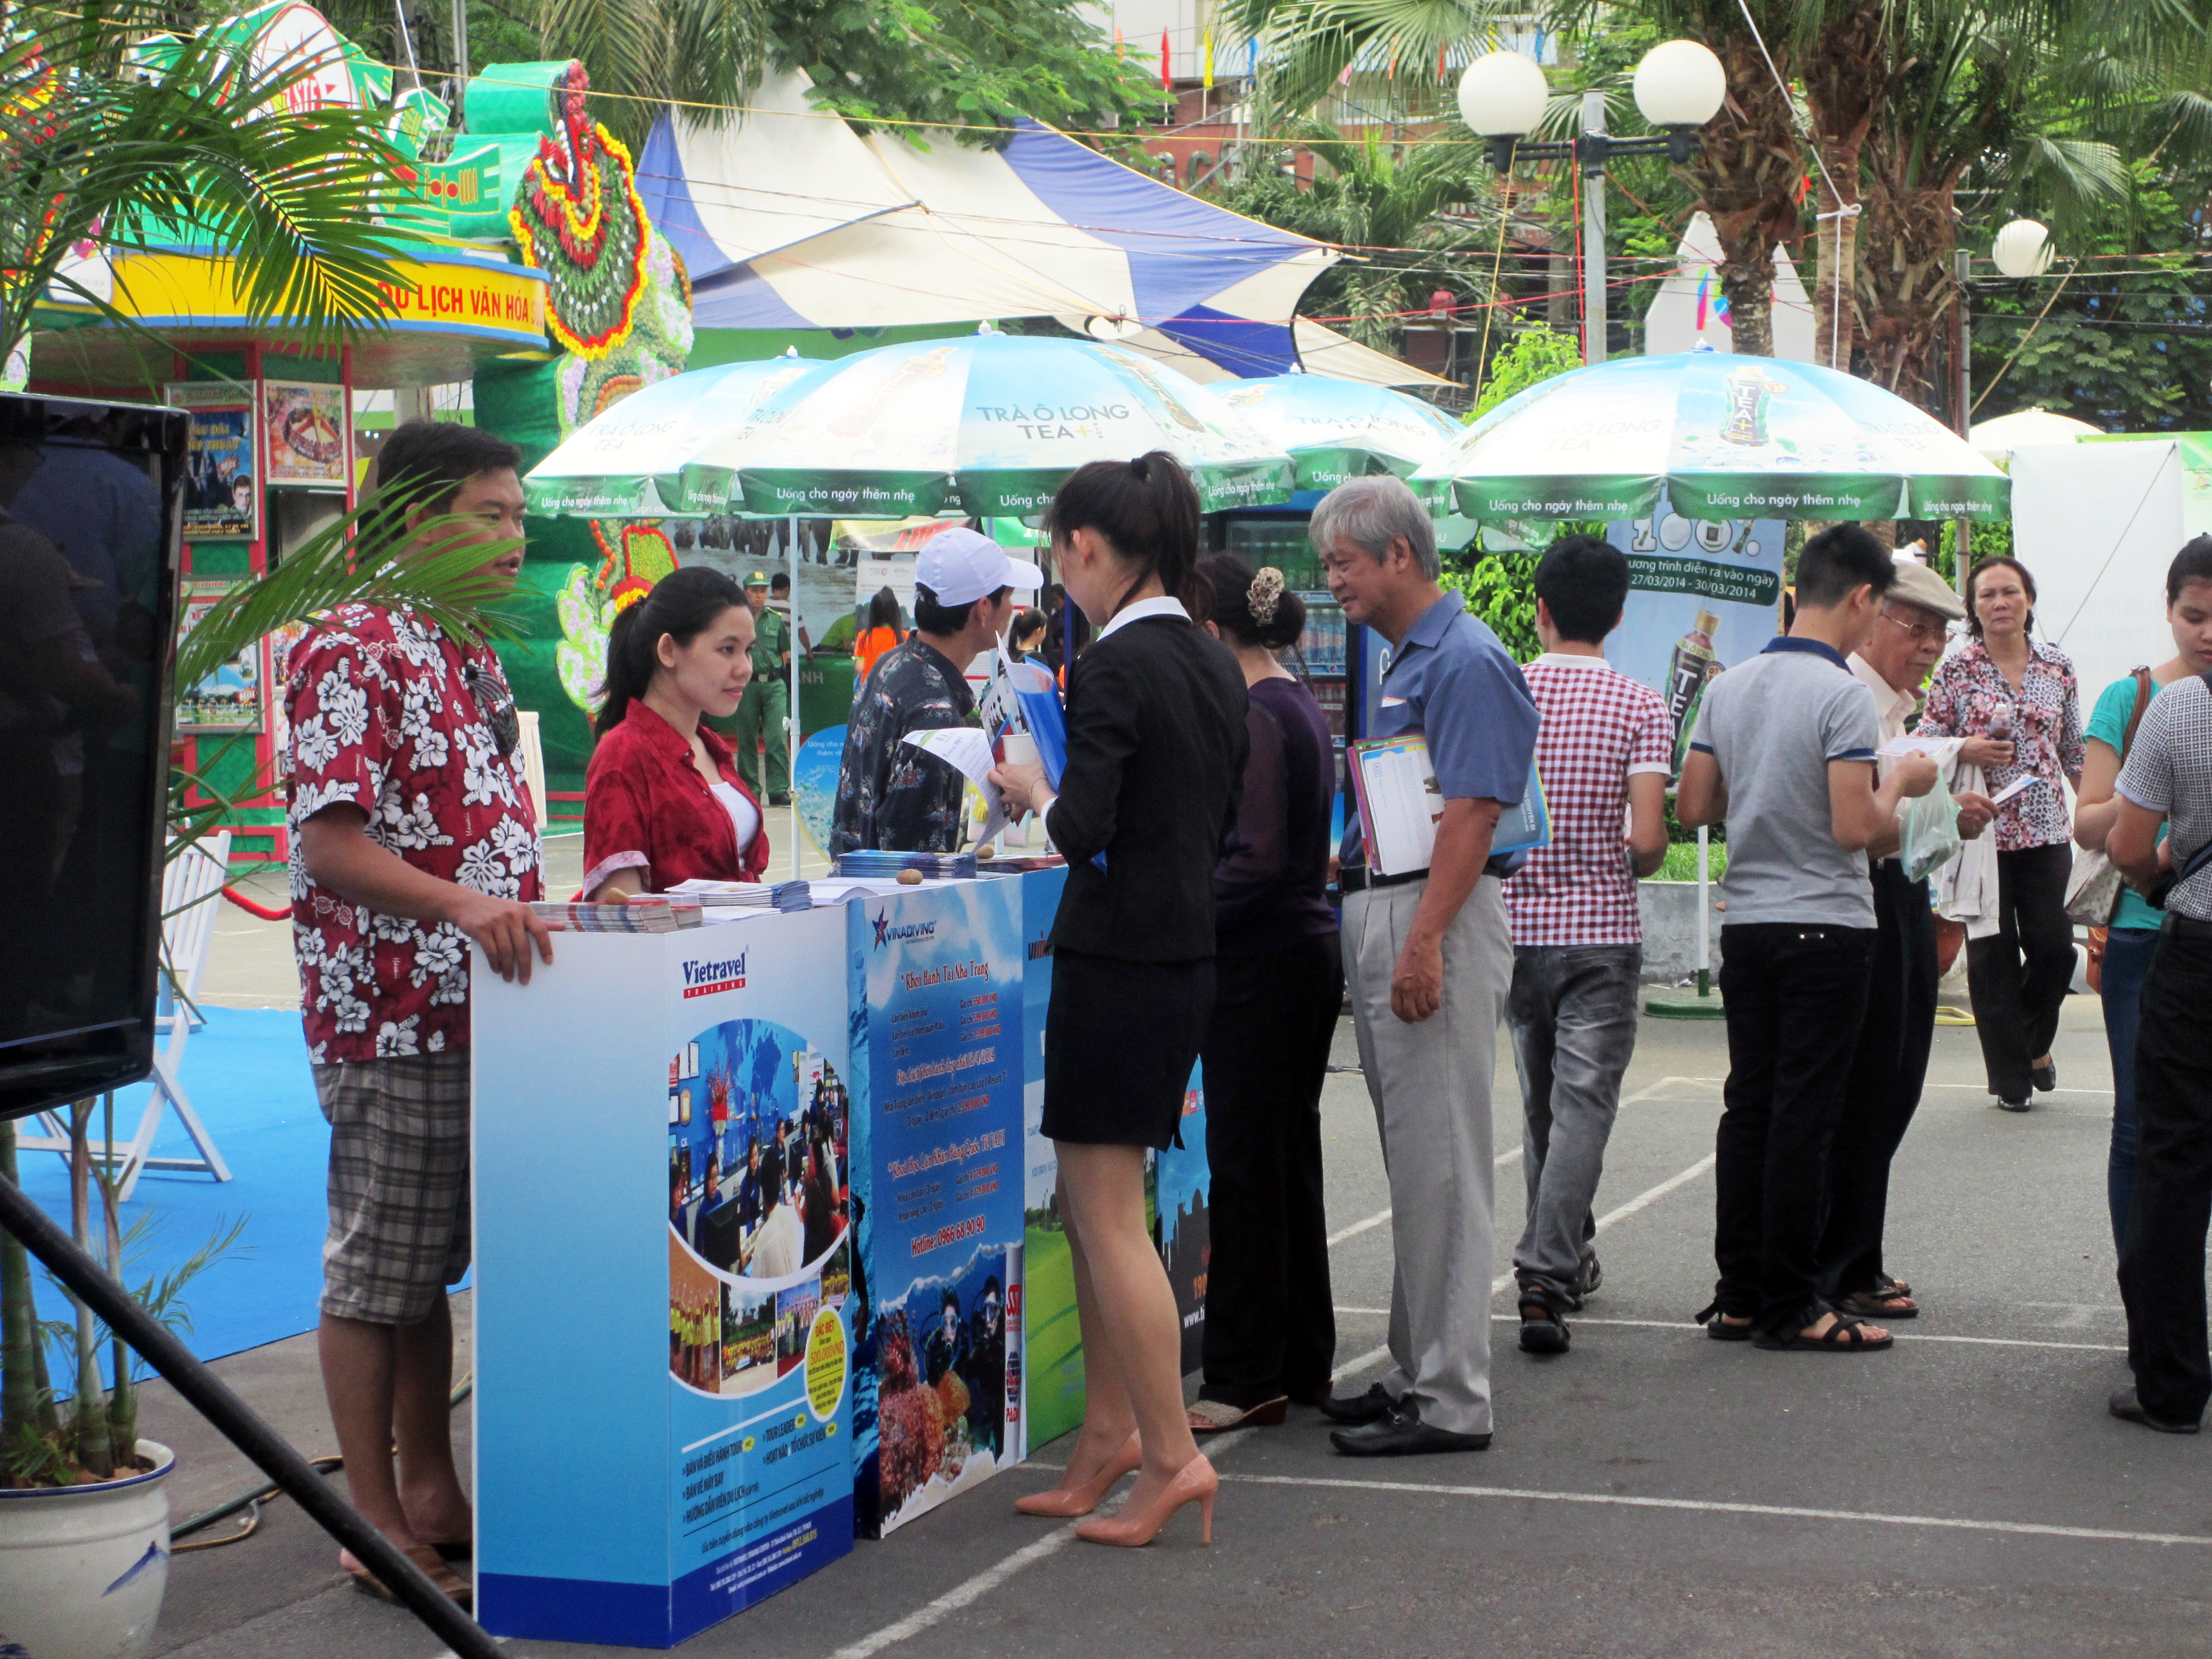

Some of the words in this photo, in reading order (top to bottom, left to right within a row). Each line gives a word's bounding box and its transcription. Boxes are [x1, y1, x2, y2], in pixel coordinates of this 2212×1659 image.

[418, 284, 463, 317] LỊCH
[470, 285, 500, 318] VĂN
[506, 289, 528, 322] HÓA
[975, 404, 1031, 421] TRÀ
[1034, 404, 1055, 421] Ô
[1060, 404, 1129, 421] LONG
[1369, 414, 1427, 436] LONG
[1312, 471, 1341, 484] Uống
[1343, 472, 1355, 483] ch
[541, 497, 560, 509] Uống
[562, 496, 574, 507] cho
[613, 494, 628, 506] nhẹ
[777, 488, 805, 501] Uống
[810, 487, 828, 499] cho
[831, 490, 858, 502] ngày
[863, 487, 890, 500] thêm
[894, 489, 915, 503] nhẹ
[1000, 493, 1032, 508] Uống
[1707, 493, 1739, 507] Uống
[1744, 494, 1765, 505] cho
[1769, 495, 1799, 508] ngày
[1803, 493, 1834, 505] thêm
[1838, 494, 1861, 508] nhẹ
[1490, 500, 1518, 513] Uống
[1522, 499, 1542, 510] cho
[1546, 501, 1572, 513] ngày
[1576, 500, 1603, 510] thêm
[1608, 499, 1628, 513] nhẹ
[1629, 560, 1656, 571] ương
[1659, 560, 1682, 572] trình
[1684, 560, 1707, 575] diễn
[1710, 567, 1721, 577] ra
[1724, 570, 1744, 581] vào
[1747, 573, 1775, 587] ngày
[1631, 574, 1686, 588] 27/03/2014
[1695, 579, 1756, 599] 30/03/2014
[800, 671, 823, 684] NH
[886, 921, 935, 941] VINADIVING
[682, 951, 746, 985] Vietravel
[956, 962, 968, 980] Nha
[969, 960, 989, 982] Trang
[687, 980, 744, 997] TRAINING
[911, 1234, 936, 1257] Hotline:
[938, 1225, 954, 1247] 0966
[956, 1221, 964, 1240] 68
[966, 1218, 974, 1238] 90
[977, 1214, 985, 1234] 90
[1193, 1273, 1208, 1300] 190
[1183, 1305, 1206, 1328] www.ti
[1006, 1407, 1020, 1423] PADI
